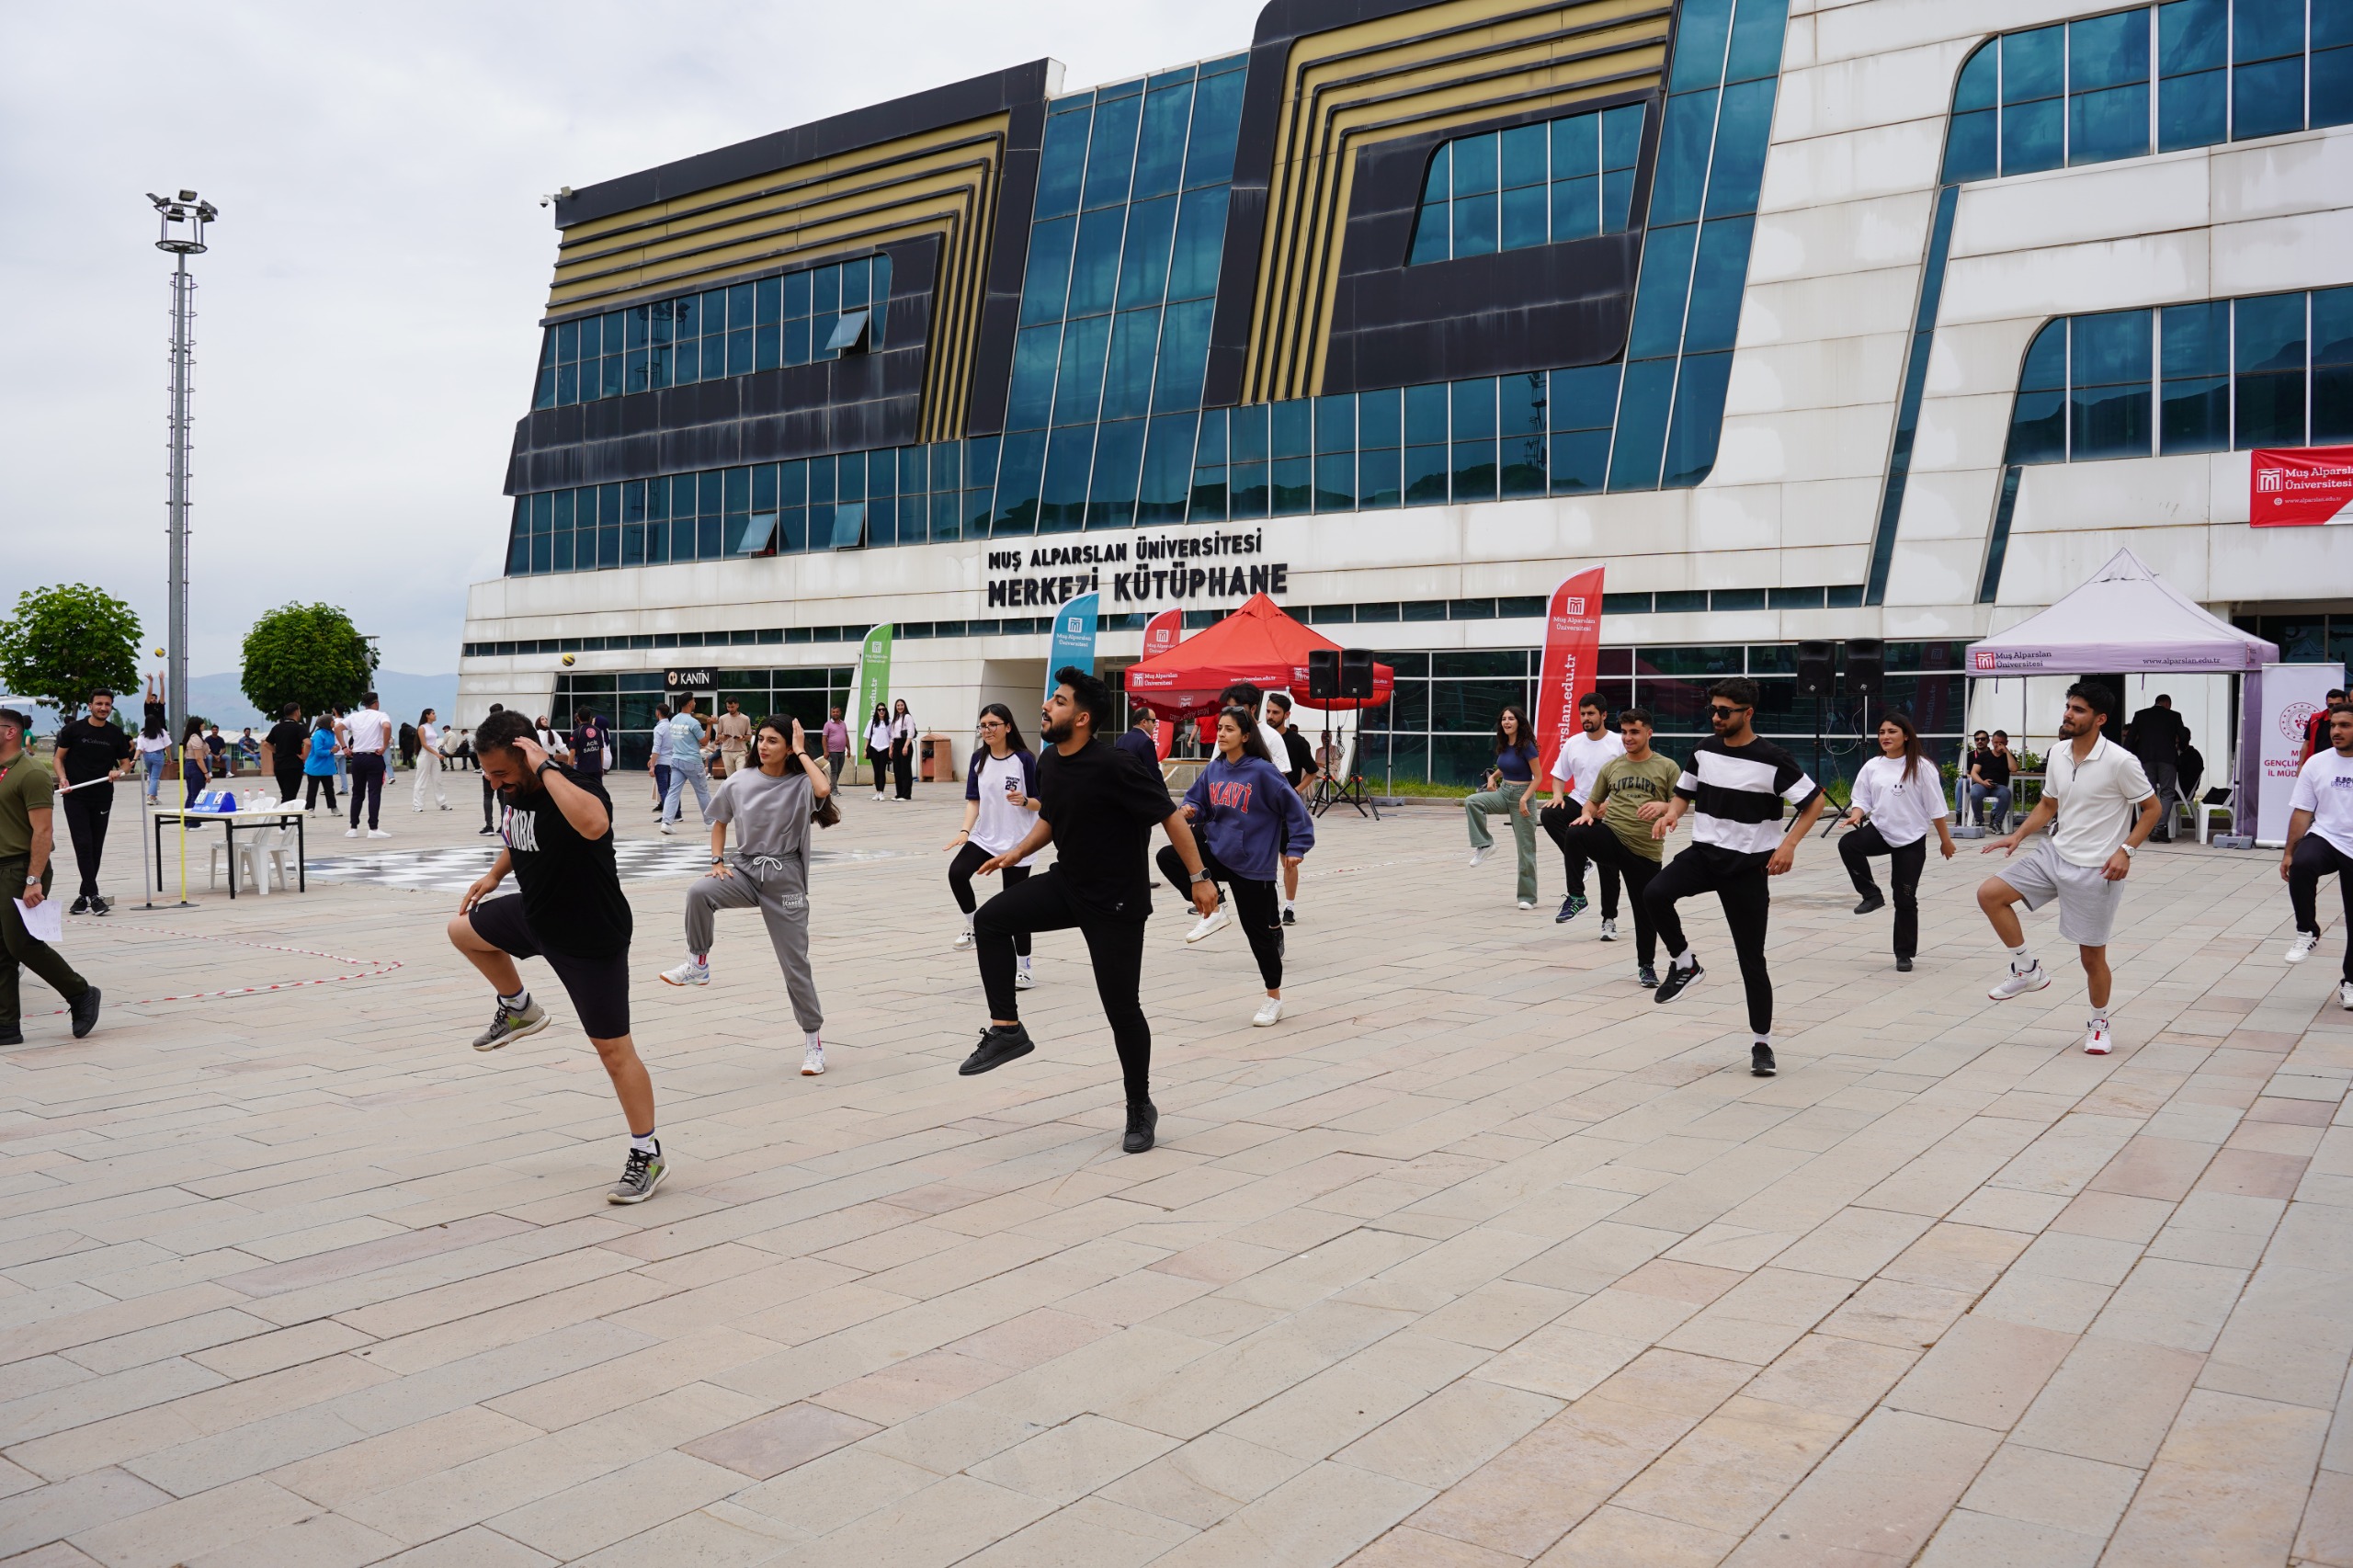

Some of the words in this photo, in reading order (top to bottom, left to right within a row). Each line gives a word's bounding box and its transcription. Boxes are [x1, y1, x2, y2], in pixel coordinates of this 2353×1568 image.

[2285, 469, 2309, 478] Muş
[2285, 479, 2352, 490] Üniversitesi
[988, 551, 1022, 573] MUŞ
[1029, 542, 1128, 567] ALPARSLAN
[1135, 528, 1263, 560] ÜNİVERSİTESİ
[988, 566, 1099, 608] MERKEZİ
[1114, 562, 1289, 602] KÜTÜPHANE
[1553, 616, 1567, 624] Muş
[1567, 617, 1596, 625] Alparslan
[1556, 624, 1592, 632] Üniversitesi
[2014, 651, 2052, 660] Alparslan
[1996, 660, 2043, 668] Üniversitesi
[2143, 657, 2221, 665] www.alparslan.edu.tr
[680, 669, 710, 685] KANTİN
[2268, 768, 2275, 777] İL
[214, 792, 222, 804] 2
[1209, 780, 1253, 814] MAVİ
[509, 808, 540, 852] NBA
